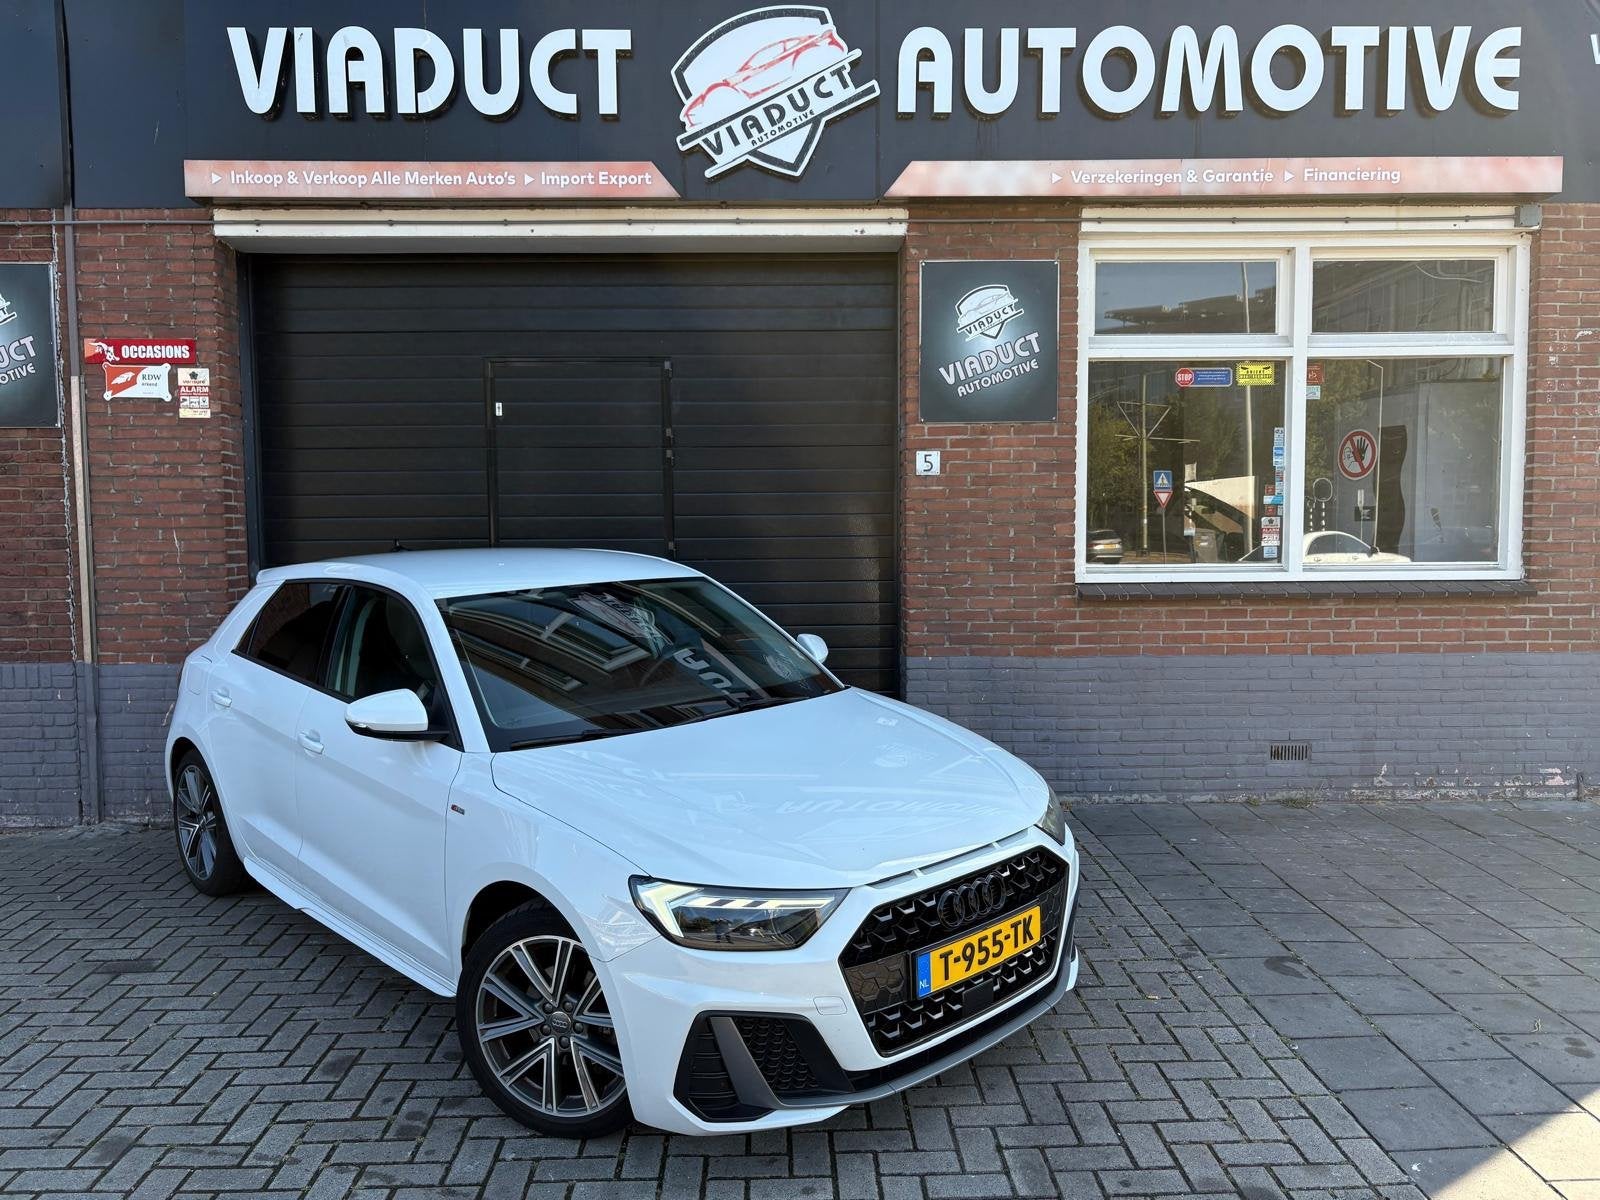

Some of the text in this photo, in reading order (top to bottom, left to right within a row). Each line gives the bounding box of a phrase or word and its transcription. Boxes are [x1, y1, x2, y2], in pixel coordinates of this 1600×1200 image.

[226, 24, 1522, 116] VIADUCT AUTOMOTIVE
[702, 65, 852, 156] VIADUCT
[751, 109, 815, 147] AUTOMOTIVE
[230, 170, 516, 187] Inkoop & Verkoop Alle Merken Auto's
[541, 171, 652, 188] Import Export
[1071, 169, 1274, 185] Verzekeringen & Garantie
[1303, 167, 1401, 185] Financiering
[965, 303, 1015, 335] VIADUCT
[121, 345, 190, 360] OCCASIONS
[938, 332, 1041, 385] VIADUCT
[141, 373, 162, 381] RDW
[957, 358, 1039, 398] AUTOMOTIVE
[1177, 373, 1192, 381] STOP
[922, 454, 934, 472] 5
[939, 914, 1034, 981] T-955-TK
[919, 980, 930, 989] NL
